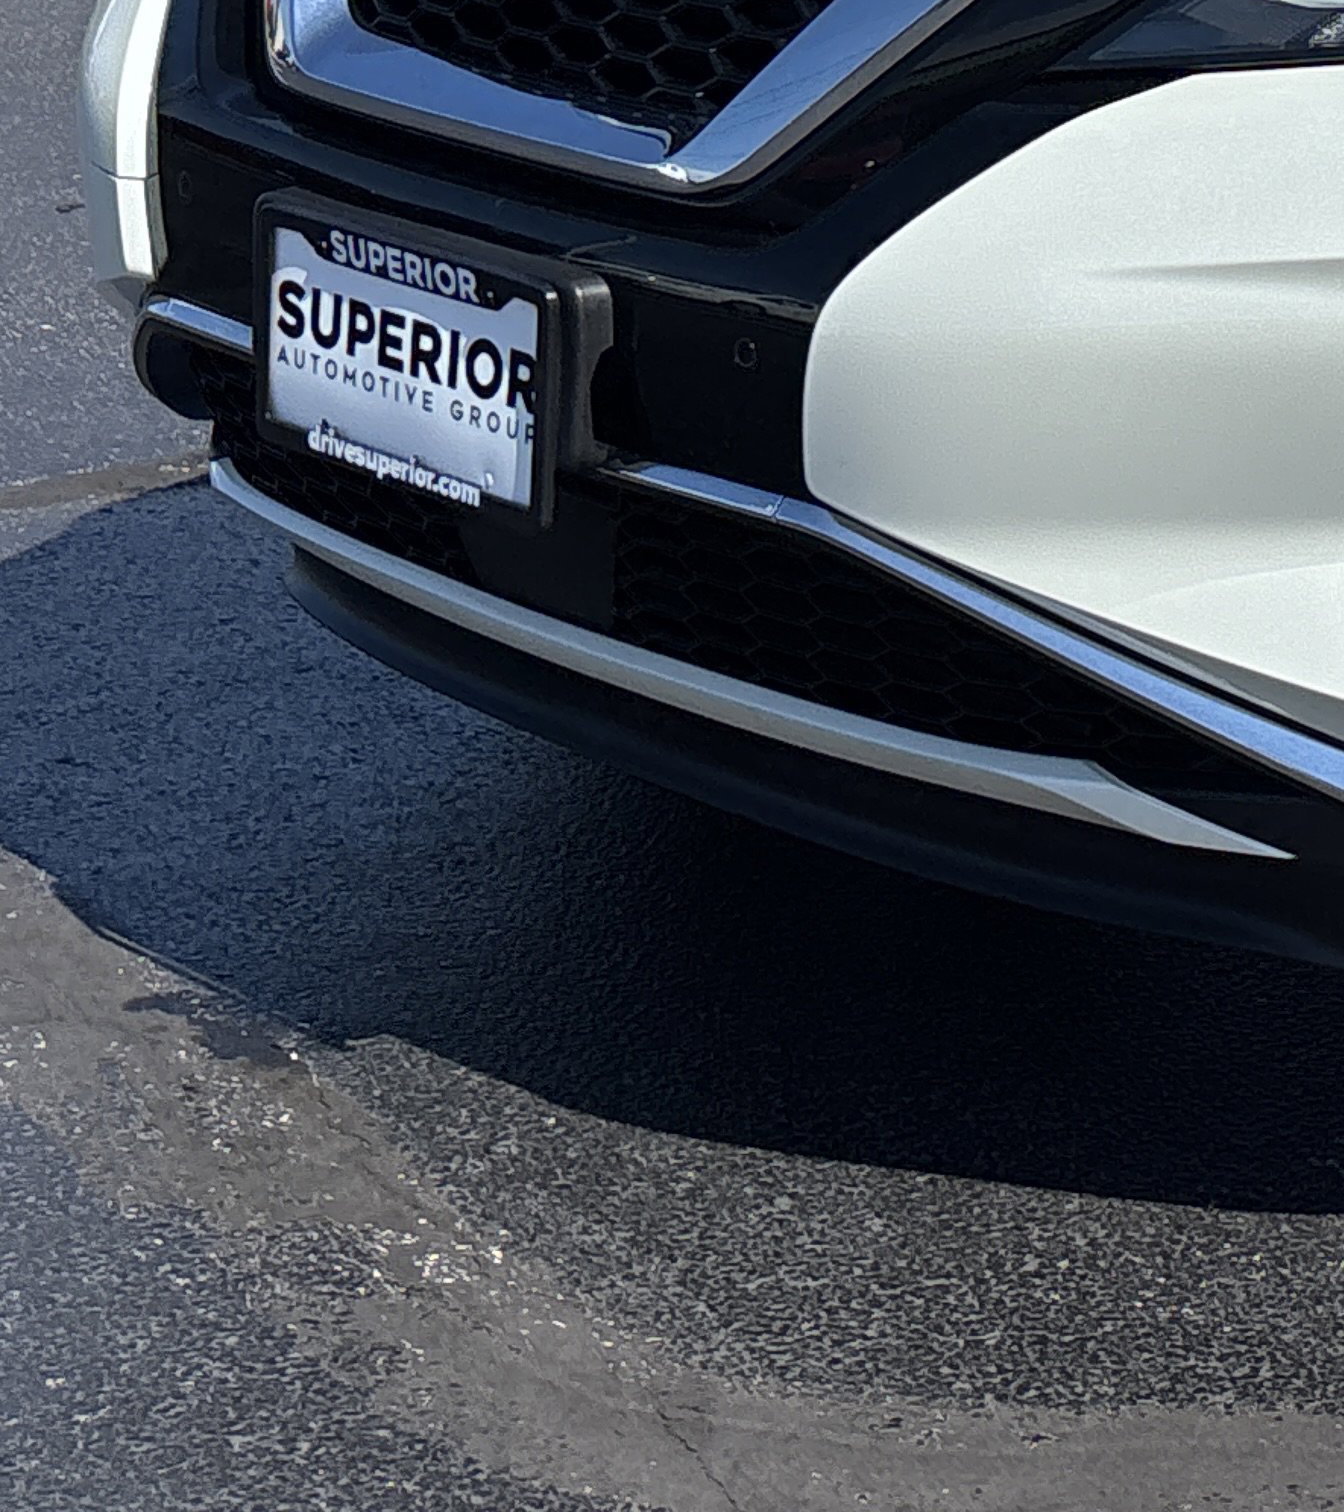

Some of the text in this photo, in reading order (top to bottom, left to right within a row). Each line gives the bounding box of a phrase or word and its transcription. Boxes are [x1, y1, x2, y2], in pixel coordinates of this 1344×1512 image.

[329, 229, 478, 306] SUPERIOR
[276, 278, 537, 414] SUPERIOR
[276, 344, 534, 445] AUTOMOTIVE GROUP
[306, 423, 482, 508] drivesuperior.com
